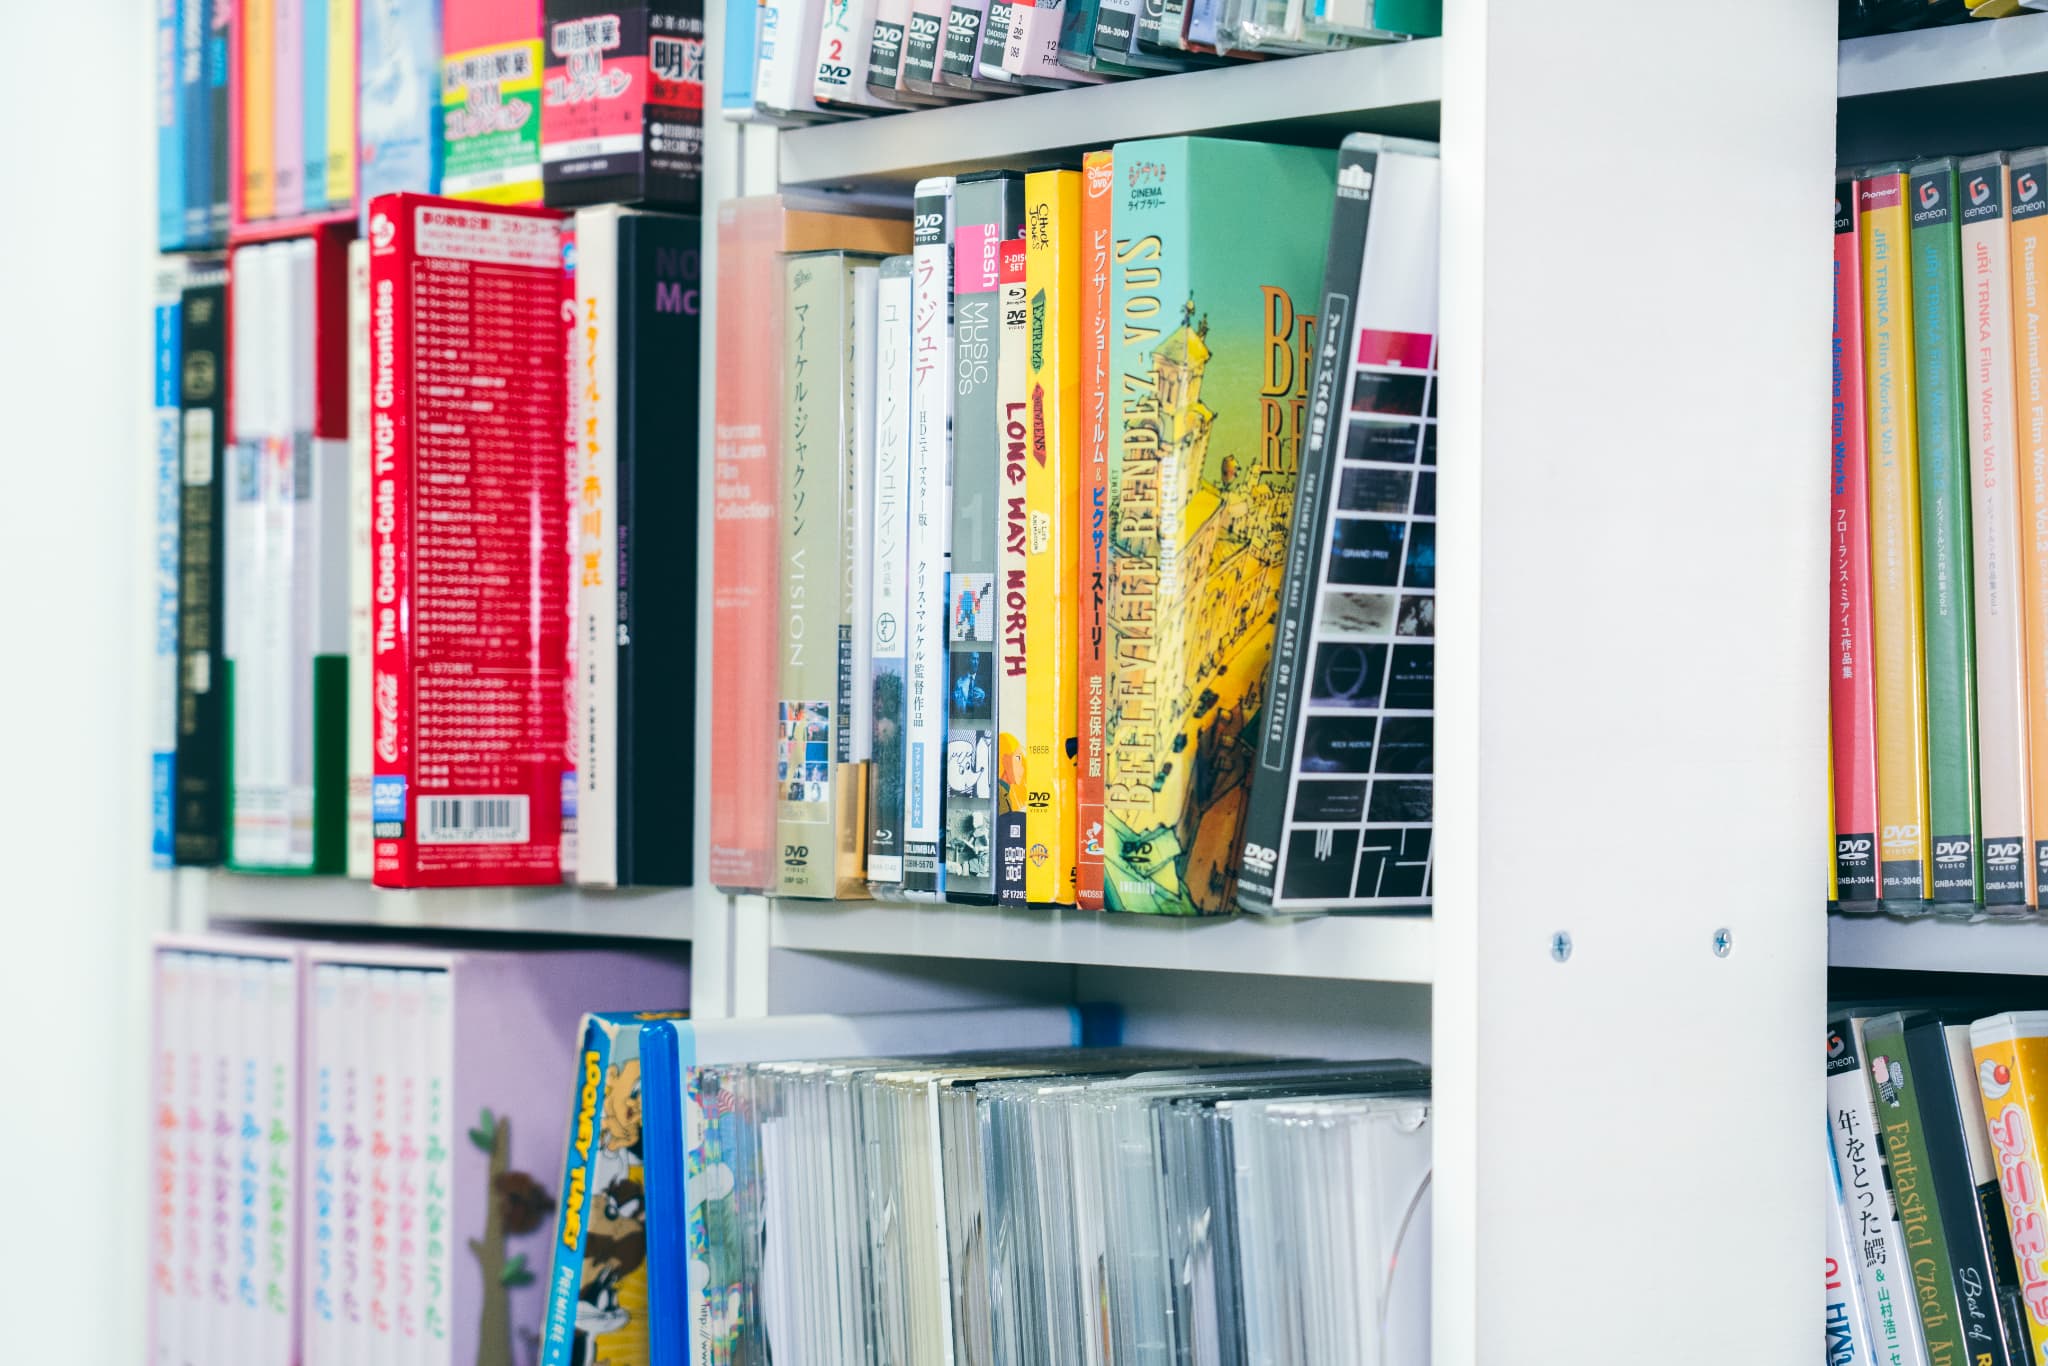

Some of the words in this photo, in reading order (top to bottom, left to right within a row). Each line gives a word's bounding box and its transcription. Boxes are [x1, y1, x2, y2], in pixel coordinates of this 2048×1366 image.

[874, 26, 902, 42] DVD
[910, 18, 939, 34] DVD
[948, 33, 971, 43] VIDEO
[949, 11, 979, 28] DVD
[829, 39, 842, 61] 2
[909, 40, 932, 49] VIDEO
[819, 64, 851, 77] DVD
[1128, 199, 1167, 211] ライブラリー
[1131, 187, 1163, 199] CINEMA
[1861, 187, 1898, 201] Pioneer
[1914, 207, 1947, 222] Geneon
[1964, 203, 1998, 218] Geneon
[2012, 200, 2046, 215] Geneon
[915, 213, 943, 228] DVD
[983, 223, 999, 288] stash
[1010, 263, 1025, 272] SET
[2024, 235, 2038, 308] Russian
[656, 282, 699, 315] Mc
[1875, 265, 1890, 327] TRNKA
[1926, 283, 1942, 345] TRNKA
[1977, 279, 1992, 343] TRNKA
[375, 279, 394, 408] Chronicles
[915, 259, 938, 388] ラ・ジュテ
[972, 302, 989, 384] MUSIC
[959, 302, 973, 395] VIDEOS
[1092, 229, 1108, 464] ピクサー・ショート・フィルム
[1877, 332, 1892, 368] Film
[1928, 349, 1943, 385] Film
[1980, 347, 1994, 384] Film
[2026, 312, 2042, 402] Animation
[1115, 234, 1162, 538] RENDEZ-VOUS
[1879, 371, 1893, 425] Works
[793, 303, 808, 537] マイケル・ジャクソン
[1833, 402, 1845, 438] Film
[1930, 388, 1944, 442] Works
[1981, 387, 1996, 442] Works
[2031, 406, 2045, 443] Film
[1006, 401, 1027, 486] LONG
[1834, 441, 1847, 496] Works
[1983, 446, 1997, 489] Vol.3
[2033, 447, 2048, 504] Works
[716, 502, 775, 519] Collection
[1006, 497, 1027, 557] WAY
[376, 480, 396, 604] Coca-Cola
[1091, 486, 1106, 662] ピクサー・ストーリー
[1836, 509, 1853, 679] フローランス・ミアイユ作品集
[789, 549, 807, 667] VISION
[1005, 569, 1027, 678] NORTH
[377, 608, 396, 654] The
[1280, 619, 1297, 659] BASS
[1106, 555, 1157, 813] BELLEVILLE
[1277, 664, 1290, 685] ON
[1089, 676, 1104, 778] 完全保存版
[1270, 692, 1288, 742] TITLES
[1028, 792, 1051, 802] DVD
[785, 845, 808, 858] DVD
[1244, 843, 1277, 862] DVD
[1838, 840, 1872, 853] DVD
[1882, 824, 1920, 839] DVD
[1936, 841, 1970, 855] DVD
[1987, 843, 2021, 857] DVD
[1989, 864, 2017, 872] VIDEO
[576, 1051, 603, 1161] LOONEY
[562, 1165, 588, 1252] TUNES
[1838, 1109, 1887, 1269] 年をとった鰐
[1875, 1269, 1887, 1283] &
[1886, 1120, 1933, 1249] Fantastic!
[1914, 1257, 1950, 1328] Czech
[1959, 1267, 1986, 1319] Best
[1968, 1323, 1993, 1342] of
